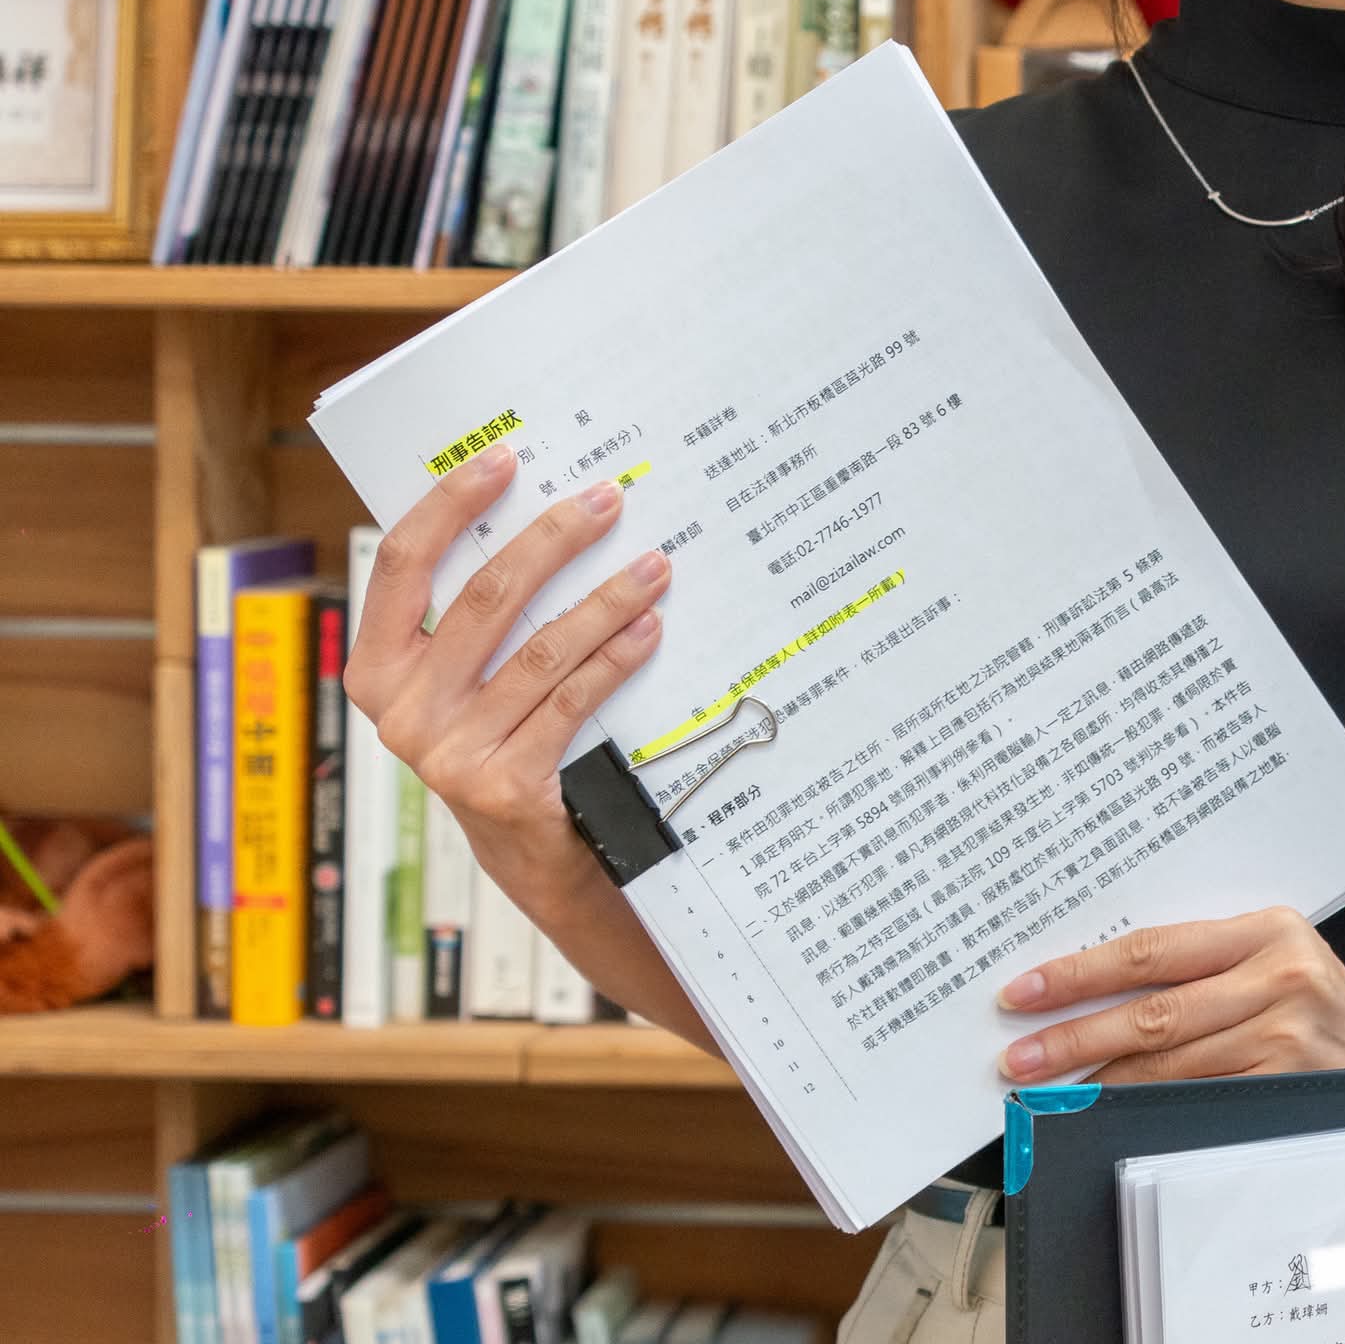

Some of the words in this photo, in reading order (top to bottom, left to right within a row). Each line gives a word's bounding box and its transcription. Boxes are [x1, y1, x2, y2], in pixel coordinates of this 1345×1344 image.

[428, 404, 524, 479] 刑事告訴狀
[572, 406, 594, 429] 股
[722, 441, 820, 514] 自在法律事務所
[473, 519, 495, 541] 案
[785, 521, 908, 612] mail@zizailaw.com
[626, 745, 646, 765] 被
